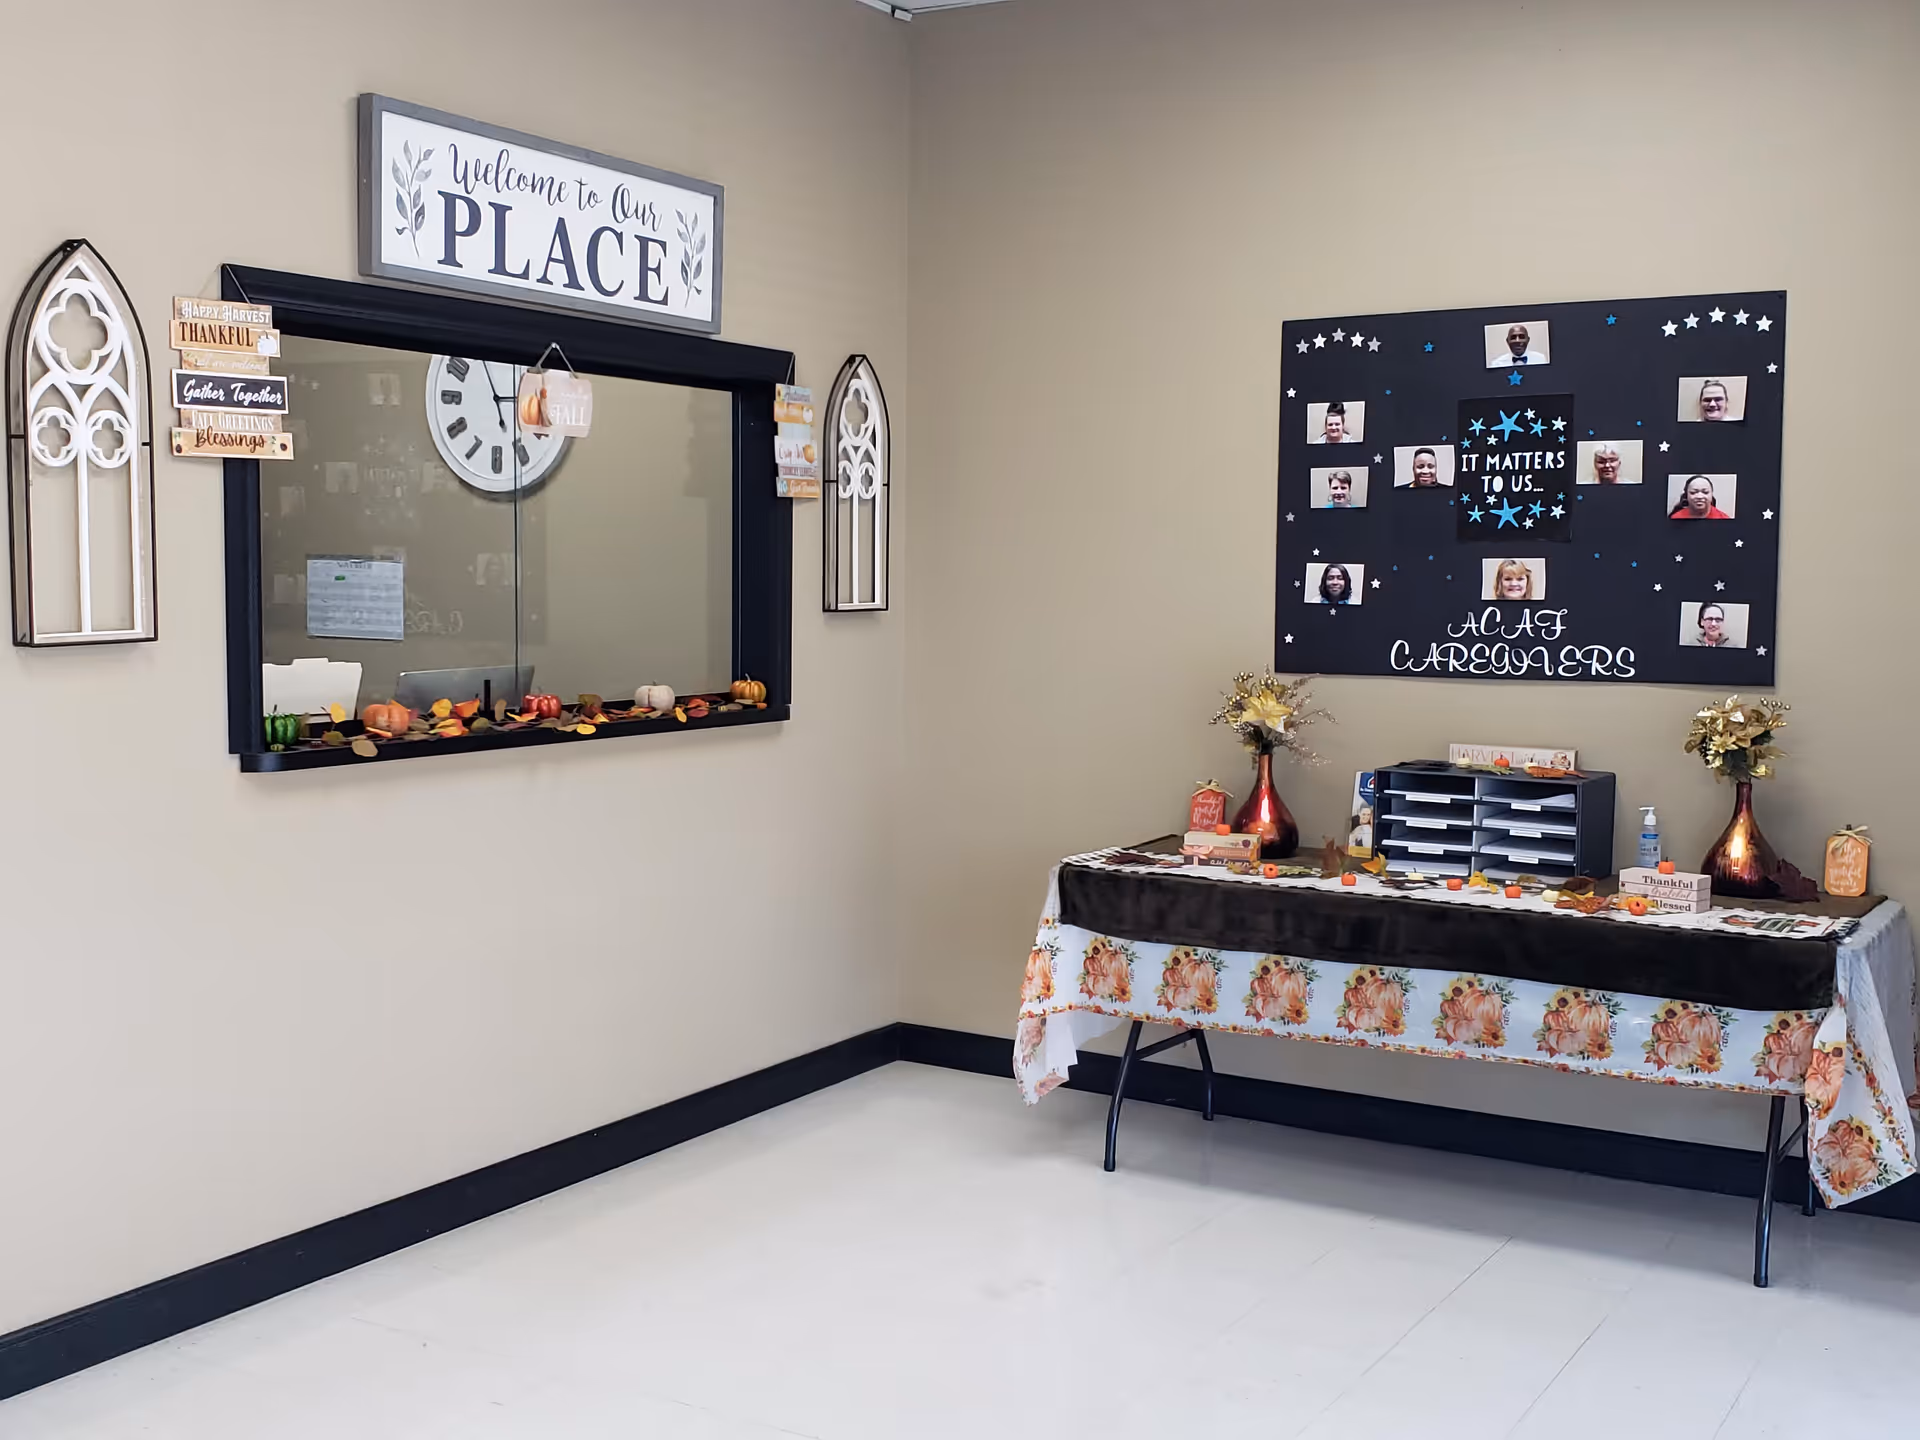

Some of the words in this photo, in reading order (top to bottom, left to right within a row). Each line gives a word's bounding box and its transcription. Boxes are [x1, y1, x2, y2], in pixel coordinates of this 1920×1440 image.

[448, 142, 570, 207] Welcome
[574, 176, 603, 212] to
[611, 182, 663, 232] Our
[436, 189, 670, 306] PLACE
[182, 301, 219, 319] HAPPY
[222, 304, 271, 323] HARVEST
[179, 321, 254, 347] THANKFUL
[183, 378, 226, 403] Gather
[230, 382, 283, 406] Together
[218, 411, 274, 432] GREETINGS
[194, 426, 267, 454] Blessings
[1461, 454, 1480, 472] IT
[1485, 451, 1565, 471] MATTERS
[1481, 475, 1504, 494] TO
[1447, 606, 1568, 641] ACAF
[1390, 639, 1636, 678] CAREGIVERS
[1451, 746, 1515, 766] HARVET
[1642, 875, 1693, 889] Thankful
